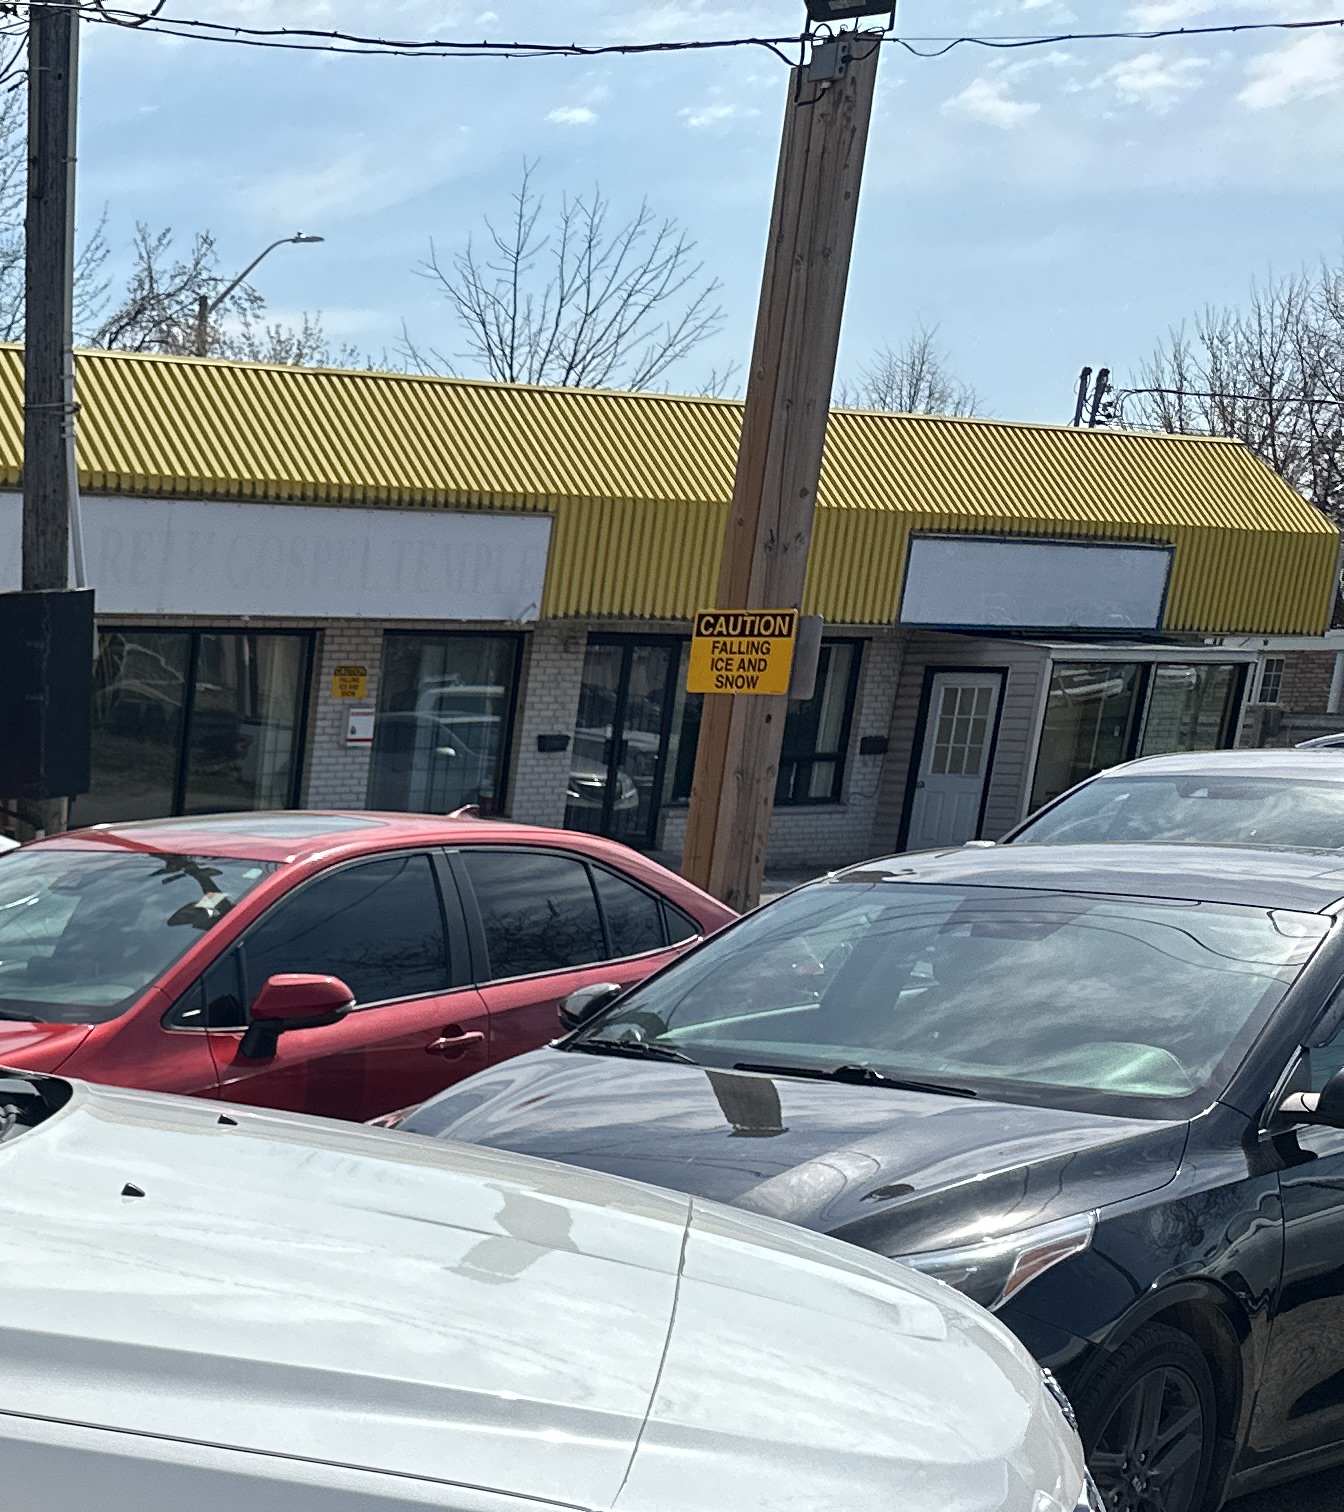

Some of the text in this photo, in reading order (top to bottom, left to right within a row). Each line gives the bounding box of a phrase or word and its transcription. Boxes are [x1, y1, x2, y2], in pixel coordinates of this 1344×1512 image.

[700, 615, 790, 635] CAUTION
[711, 640, 771, 655] FALLING
[710, 658, 768, 672] ICE AND
[714, 674, 760, 689] SNOW
